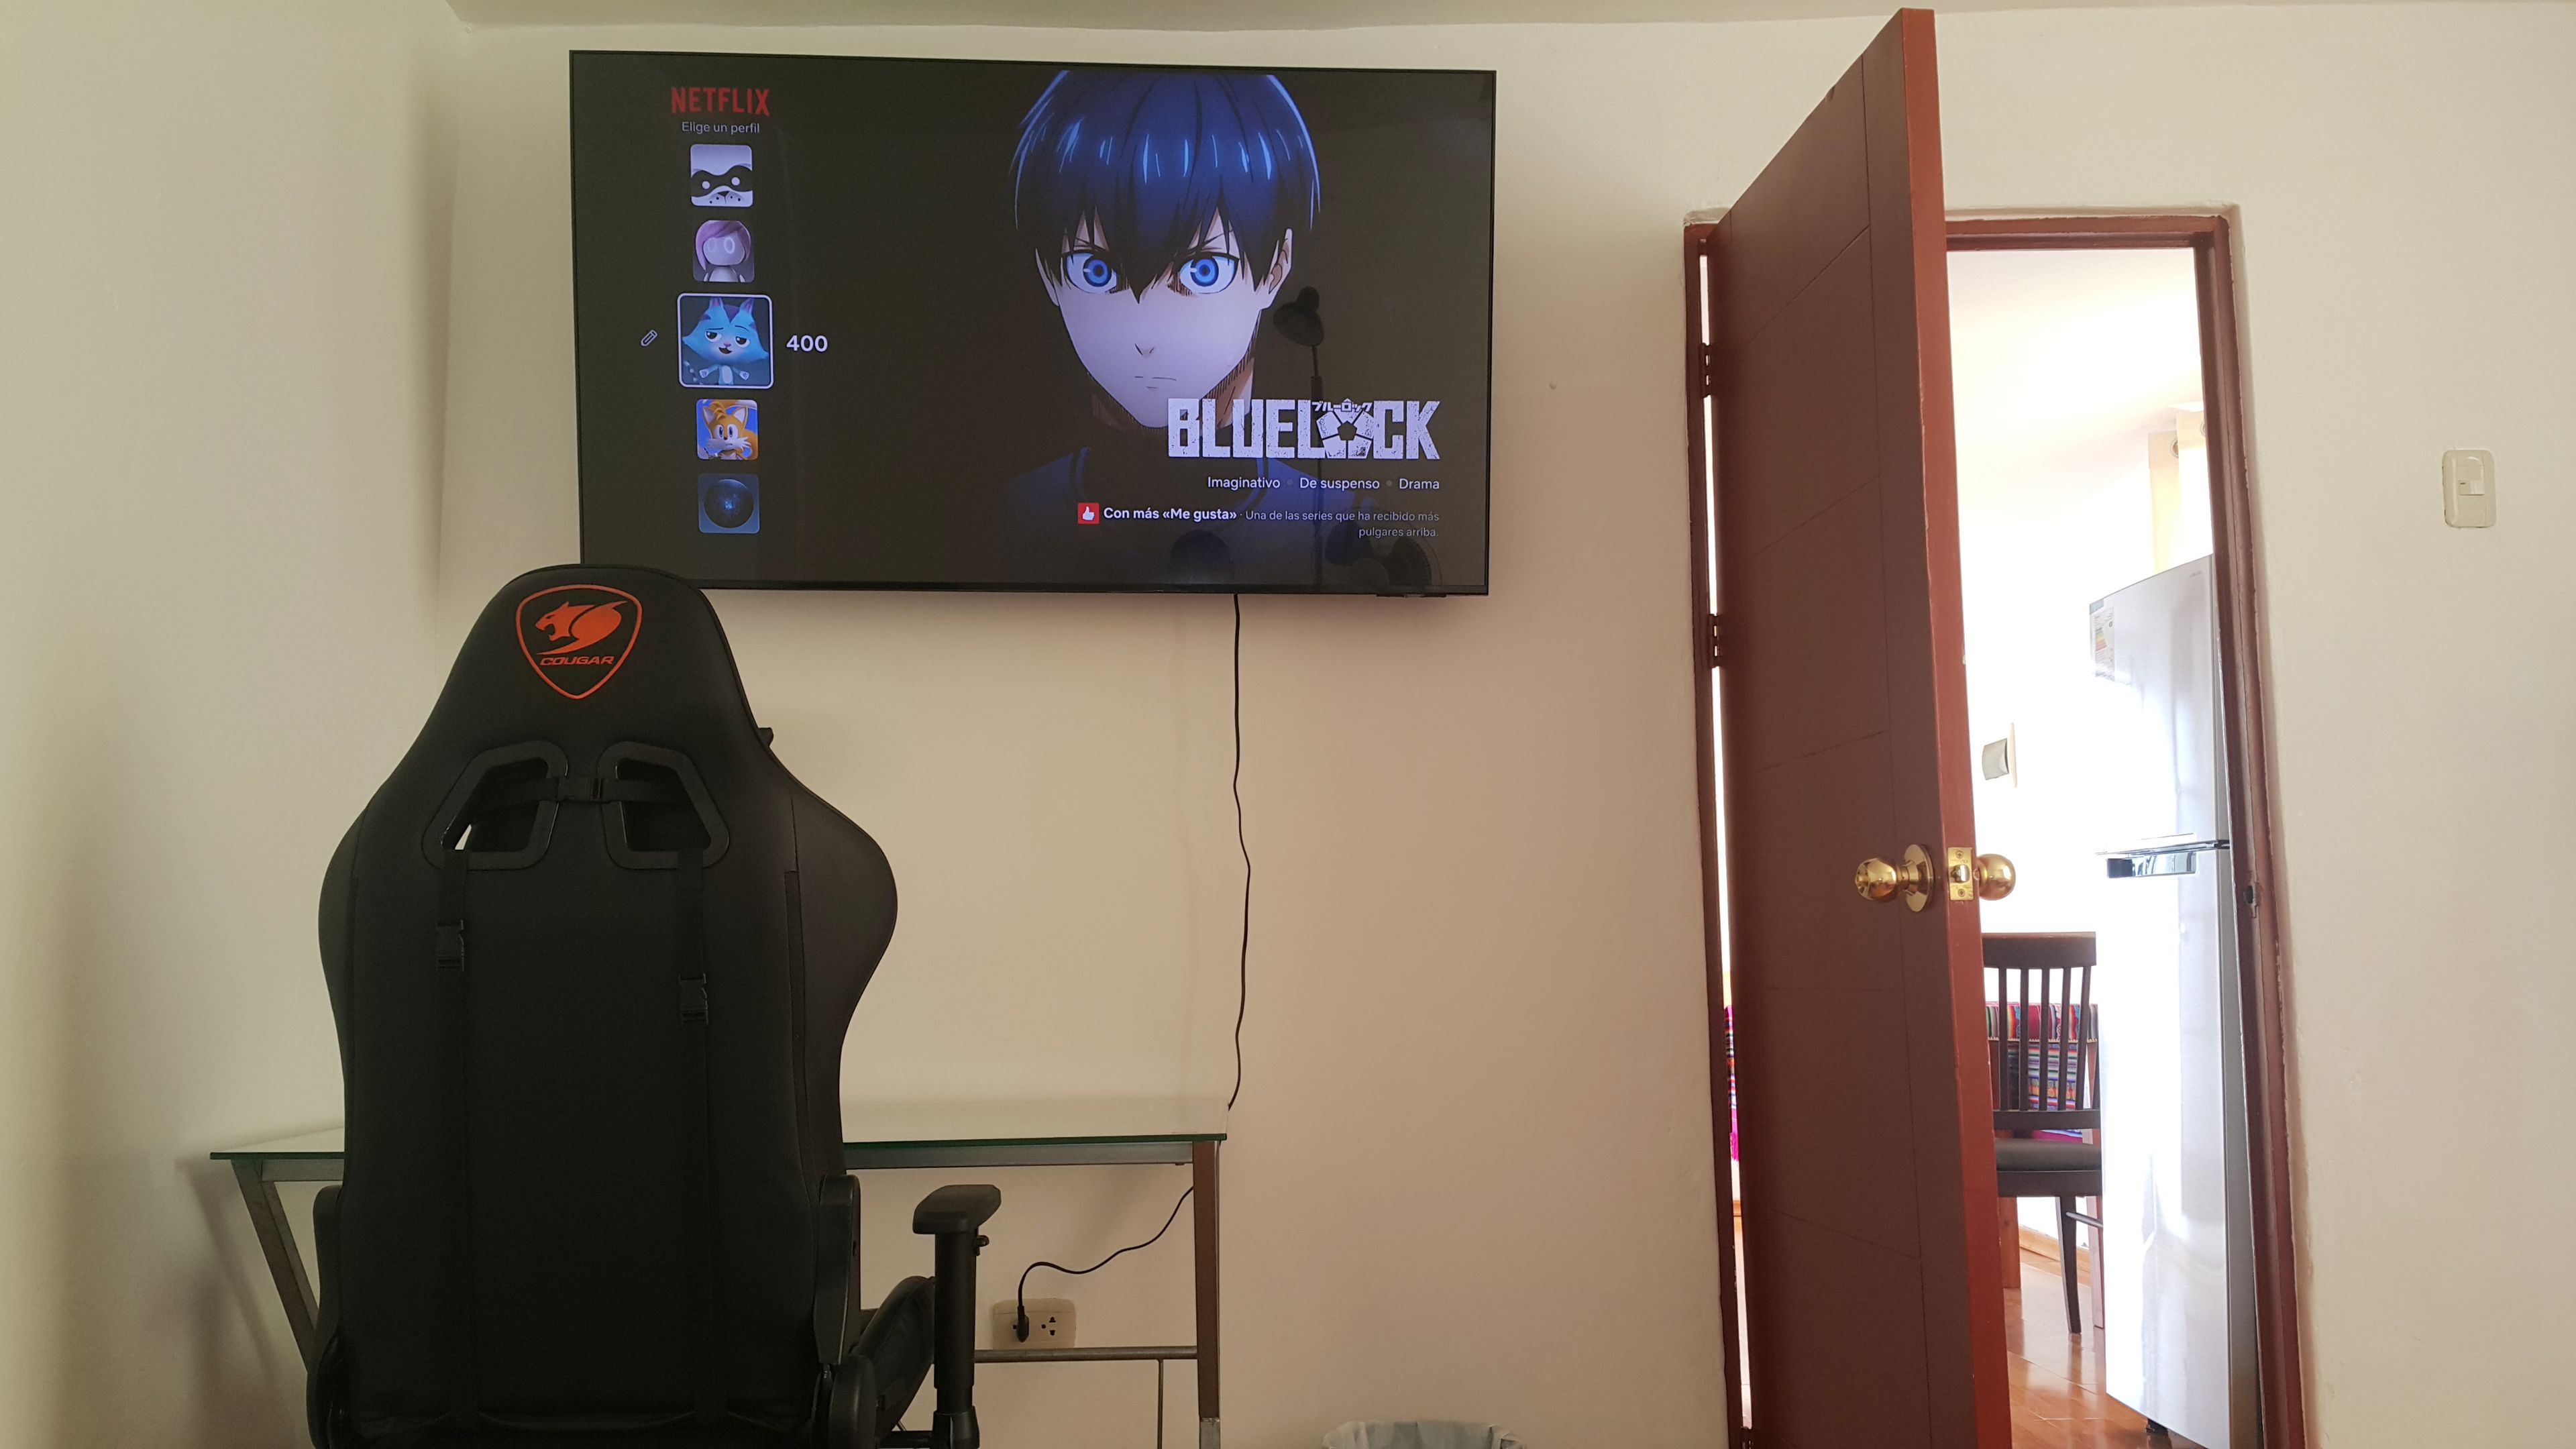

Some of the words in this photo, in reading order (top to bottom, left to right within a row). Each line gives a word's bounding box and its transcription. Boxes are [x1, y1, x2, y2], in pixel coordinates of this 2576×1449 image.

[671, 87, 770, 117] NETFLIX
[682, 121, 710, 134] Elige
[713, 124, 727, 132] un
[731, 122, 760, 135] perfil
[786, 335, 828, 352] 400
[1208, 476, 1281, 490] Imaginativo
[1299, 477, 1317, 489] De
[1320, 478, 1380, 491] suspenso
[1399, 478, 1440, 490] Drama
[1104, 507, 1129, 519] Con
[1133, 507, 1159, 519] más
[1163, 508, 1190, 520] «Me
[1193, 510, 1237, 523] gusta»
[1245, 511, 1267, 520] Una
[1269, 511, 1283, 521] de
[1285, 511, 1299, 521] las
[1302, 511, 1333, 521] series
[1335, 513, 1356, 523] que
[1358, 511, 1371, 521] ha
[1373, 511, 1415, 522] recibido
[1417, 511, 1440, 522] más
[1358, 527, 1404, 539] pulgares
[1406, 527, 1439, 537] arriba.
[539, 655, 615, 666] COUGAR
